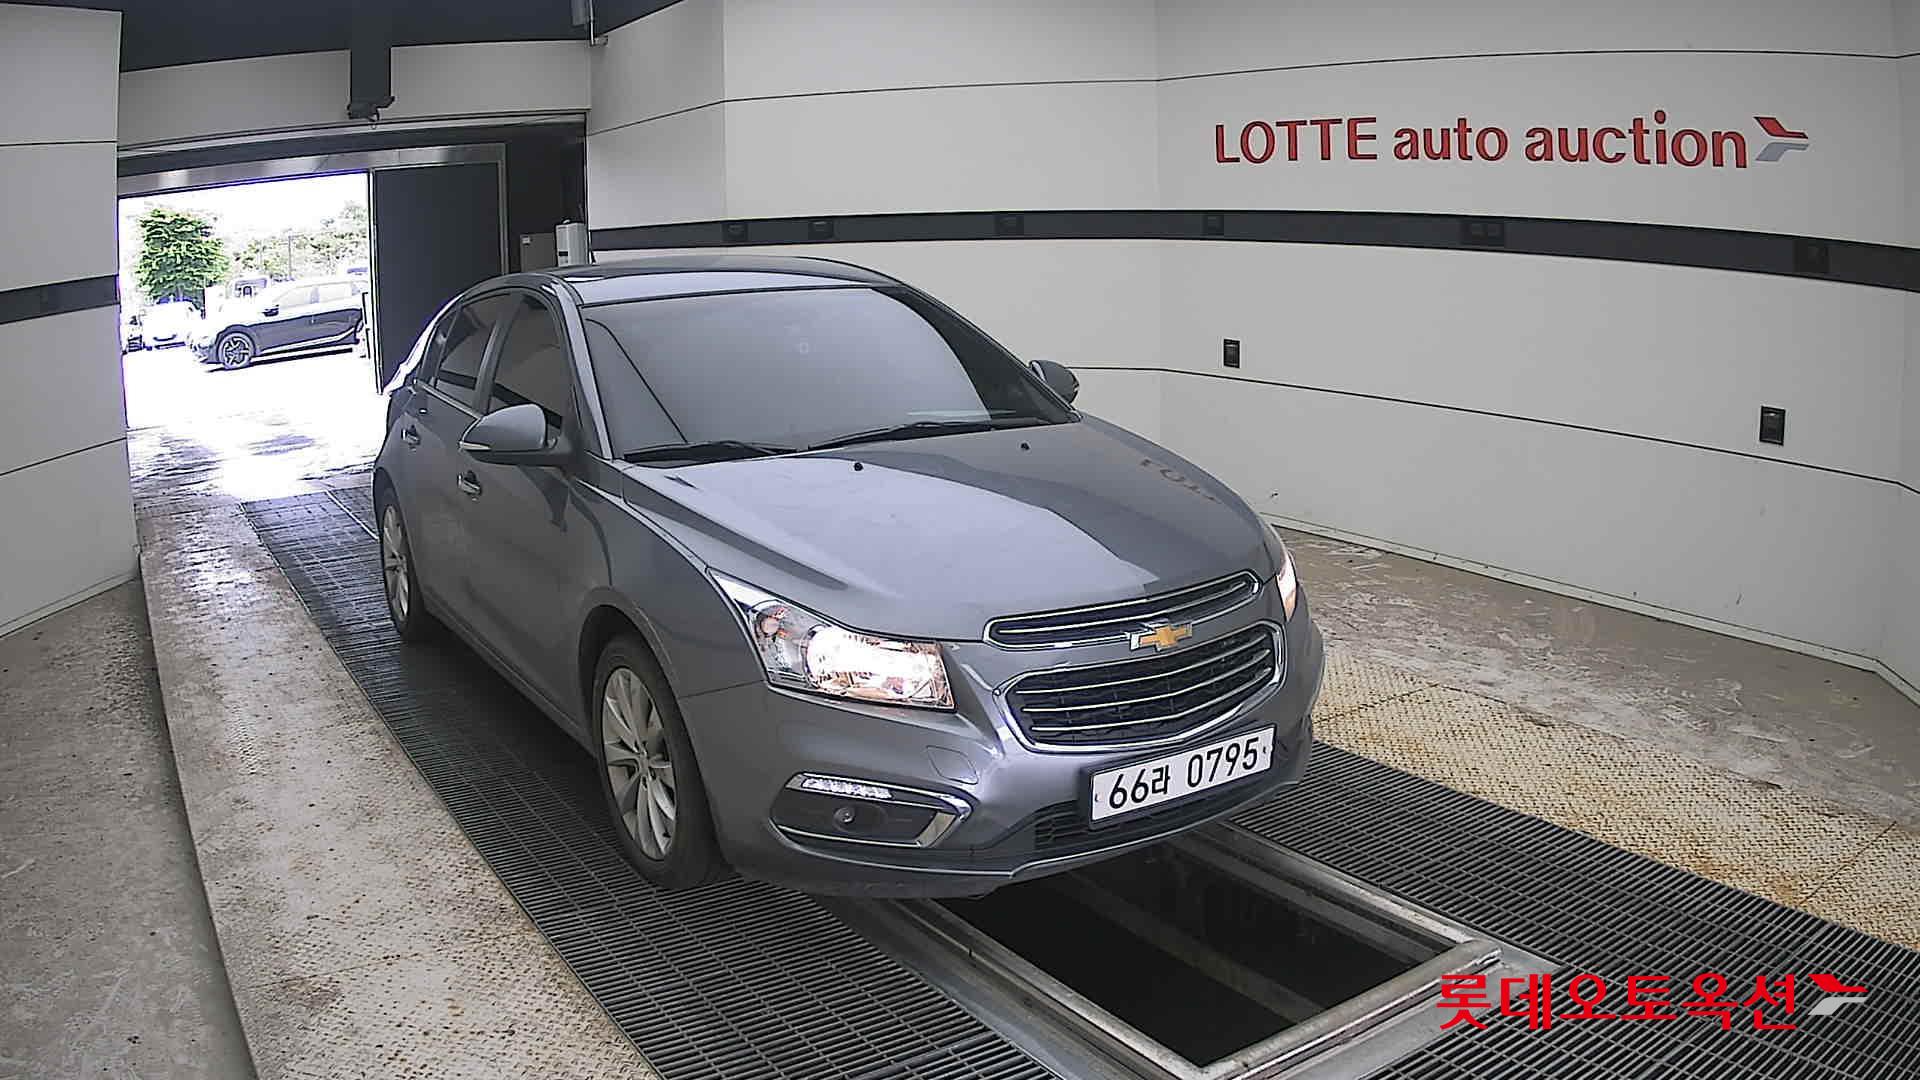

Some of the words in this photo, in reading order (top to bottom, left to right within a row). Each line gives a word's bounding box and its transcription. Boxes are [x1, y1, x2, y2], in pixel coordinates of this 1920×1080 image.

[1215, 116, 1378, 164] LOTTE
[1393, 117, 1509, 162] auto
[1524, 110, 1748, 169] auction
[1108, 764, 1171, 810] 66라
[1186, 737, 1260, 788] 0795
